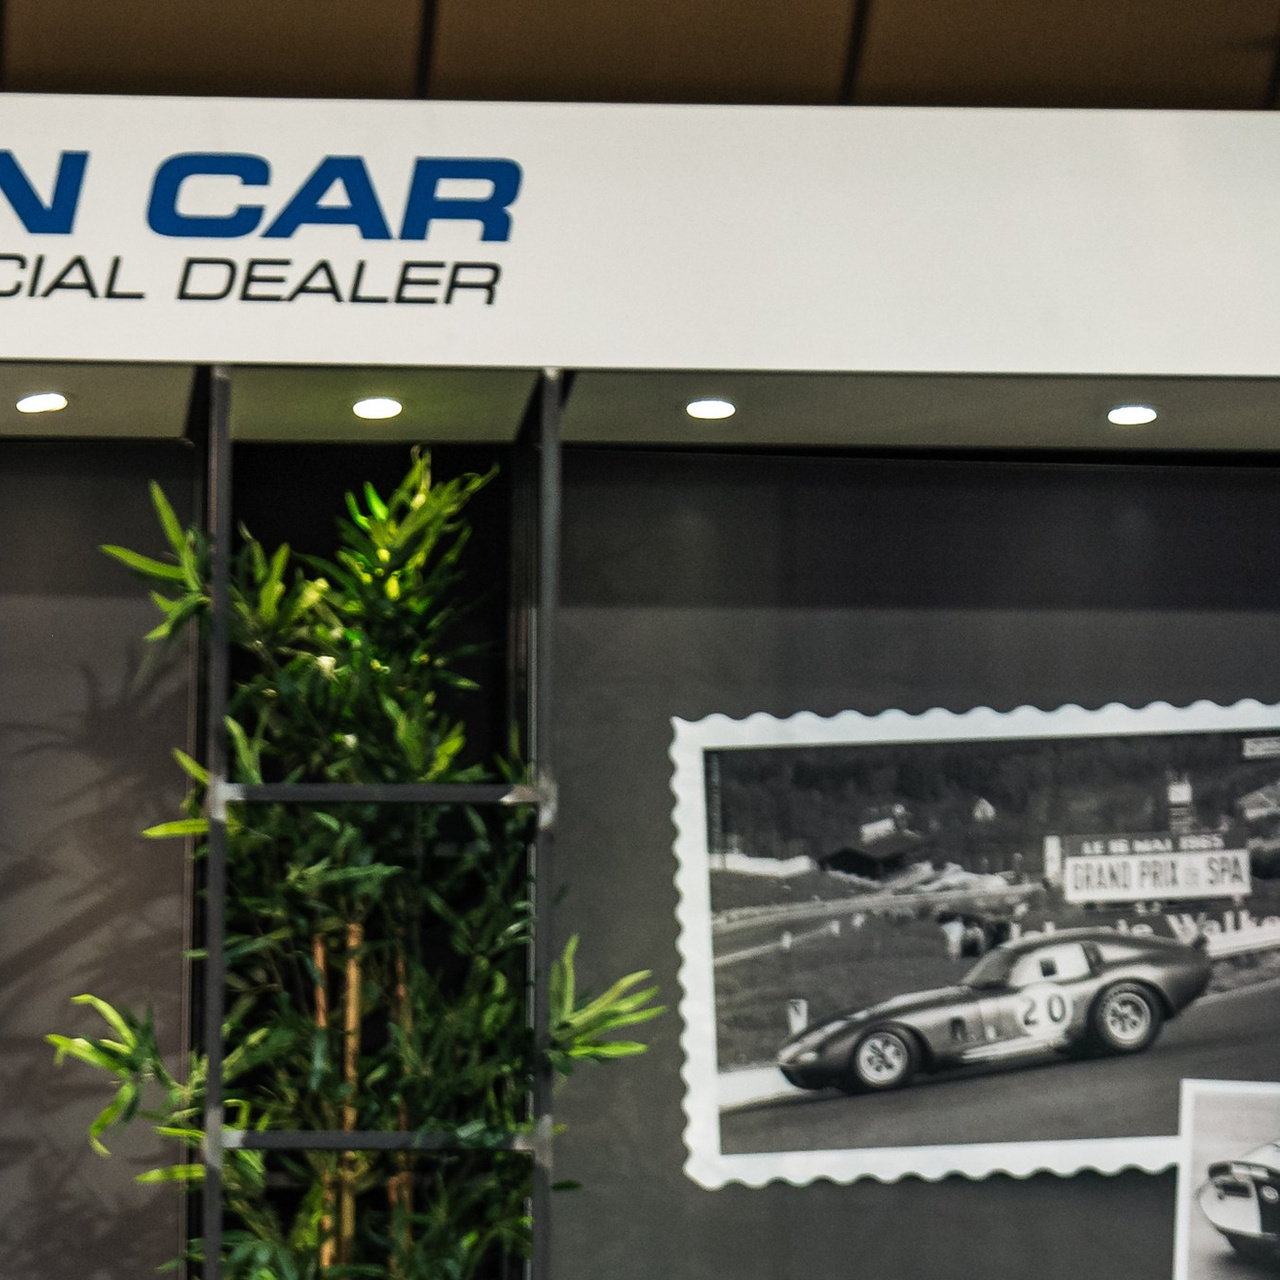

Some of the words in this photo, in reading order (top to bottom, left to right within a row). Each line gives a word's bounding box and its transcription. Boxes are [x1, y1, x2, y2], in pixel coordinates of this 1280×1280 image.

[146, 152, 523, 243] CAR
[176, 256, 502, 306] DEALER
[1072, 861, 1131, 891] GRAND
[1138, 858, 1180, 888] PRIX
[1206, 856, 1244, 885] SPA
[1023, 993, 1067, 1026] 20
